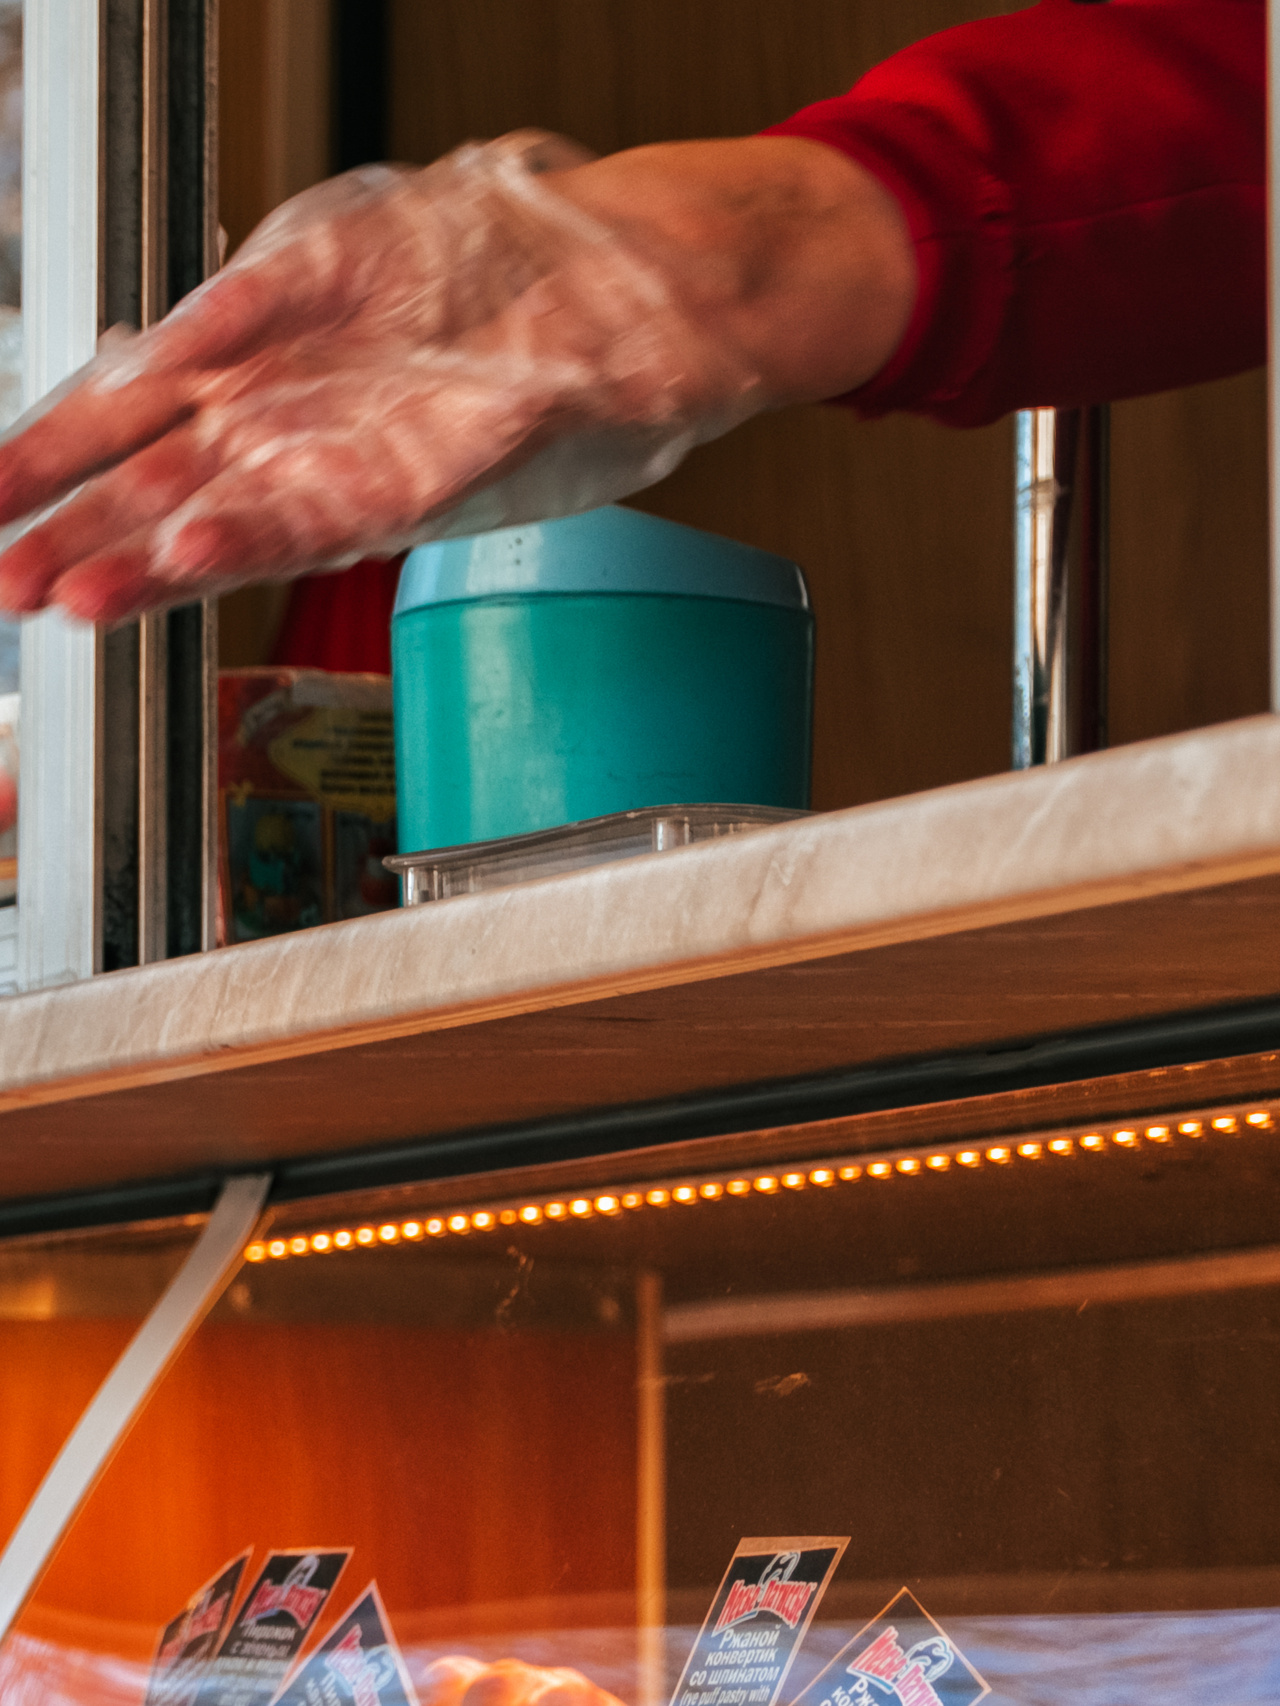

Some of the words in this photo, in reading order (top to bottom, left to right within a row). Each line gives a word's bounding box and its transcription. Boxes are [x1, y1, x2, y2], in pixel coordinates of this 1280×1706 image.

[719, 1624, 781, 1649] Ржаной
[705, 1648, 779, 1668] конвертик
[689, 1670, 707, 1687] со
[707, 1666, 781, 1685] шпинатом
[700, 1686, 721, 1705] puff
[719, 1687, 749, 1705] pastry
[748, 1684, 771, 1702] with
